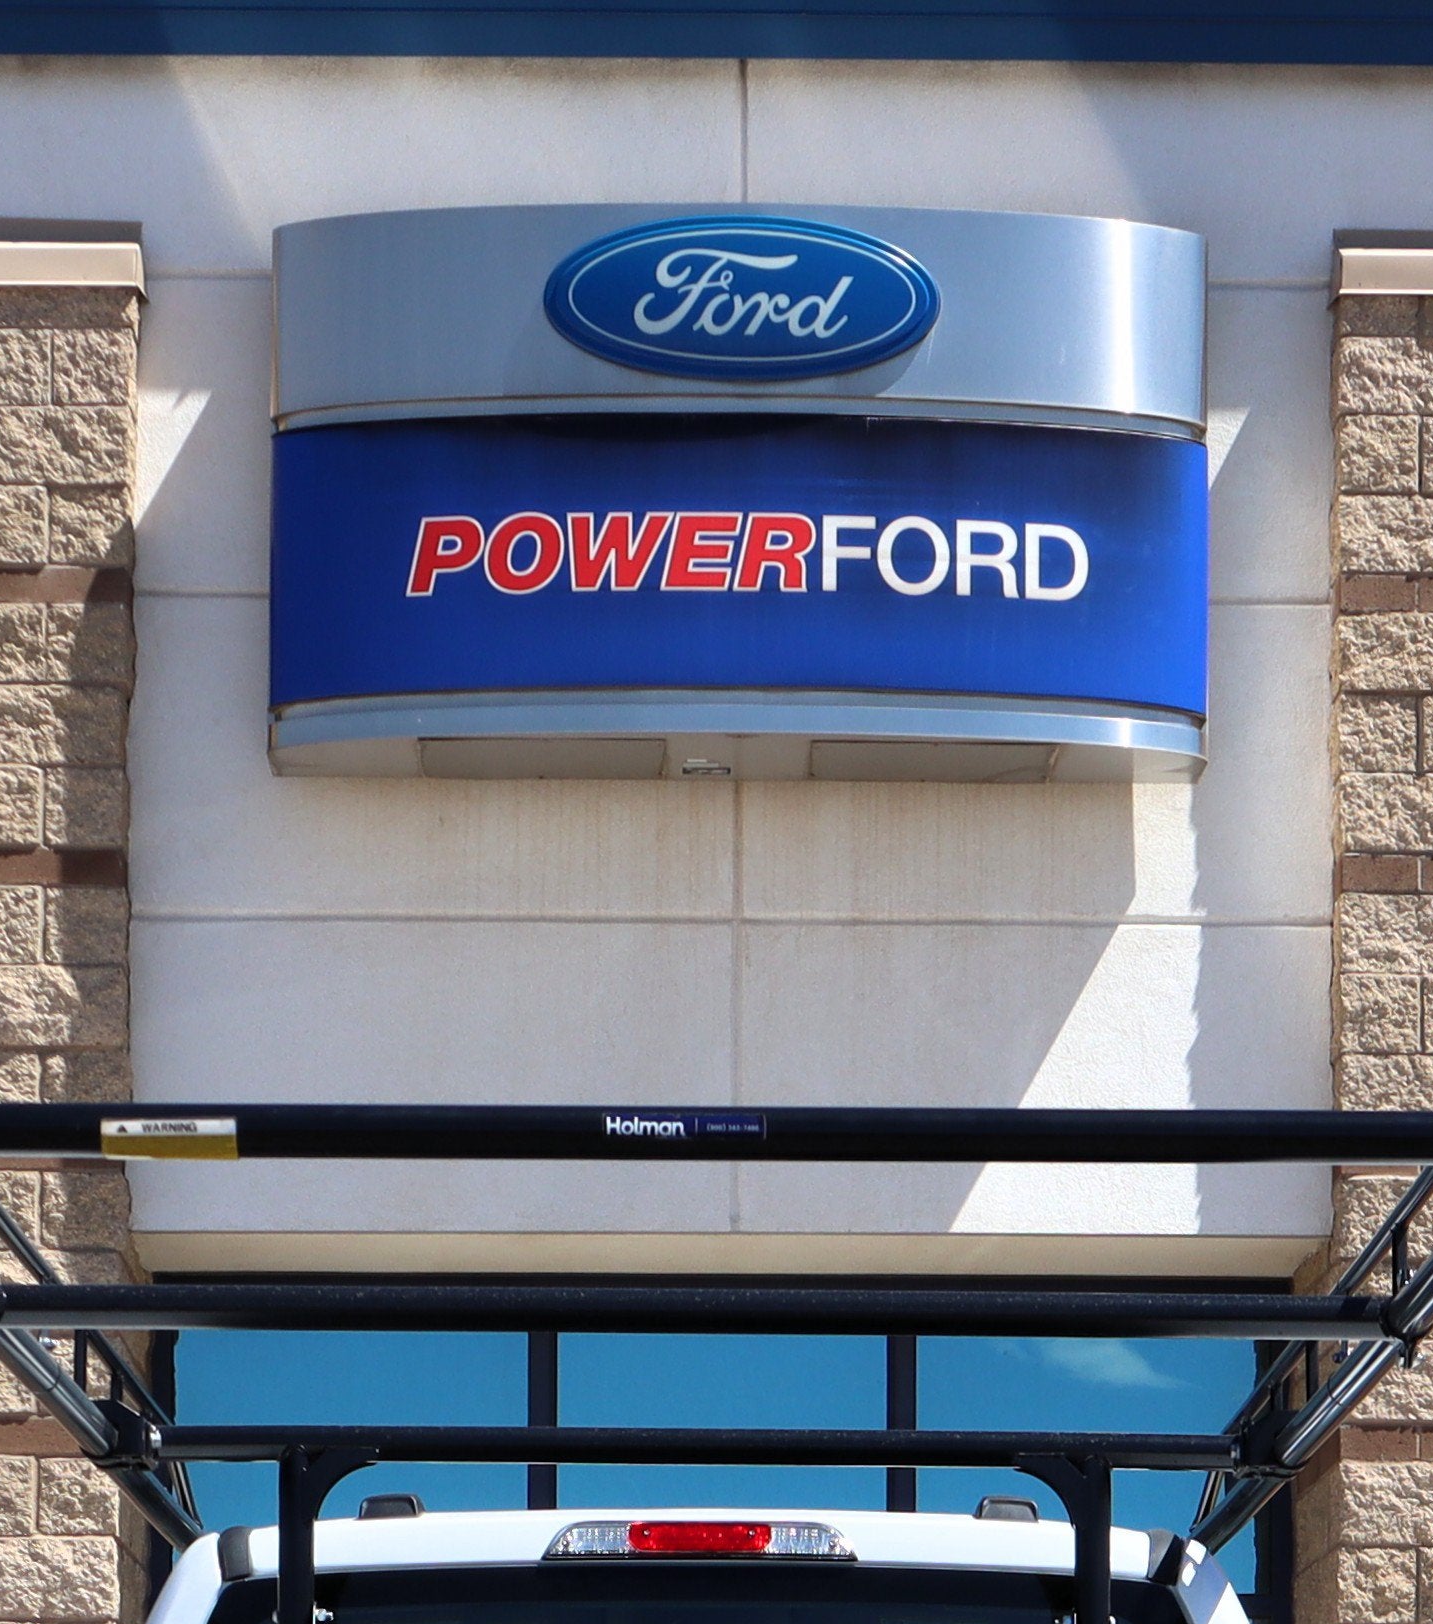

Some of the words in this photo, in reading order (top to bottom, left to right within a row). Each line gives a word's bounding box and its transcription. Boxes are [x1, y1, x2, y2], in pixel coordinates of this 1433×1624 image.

[633, 247, 854, 340] Ford
[405, 509, 1091, 601] POWERFORD
[142, 1122, 197, 1133] WARNING
[606, 1116, 685, 1136] Holman
